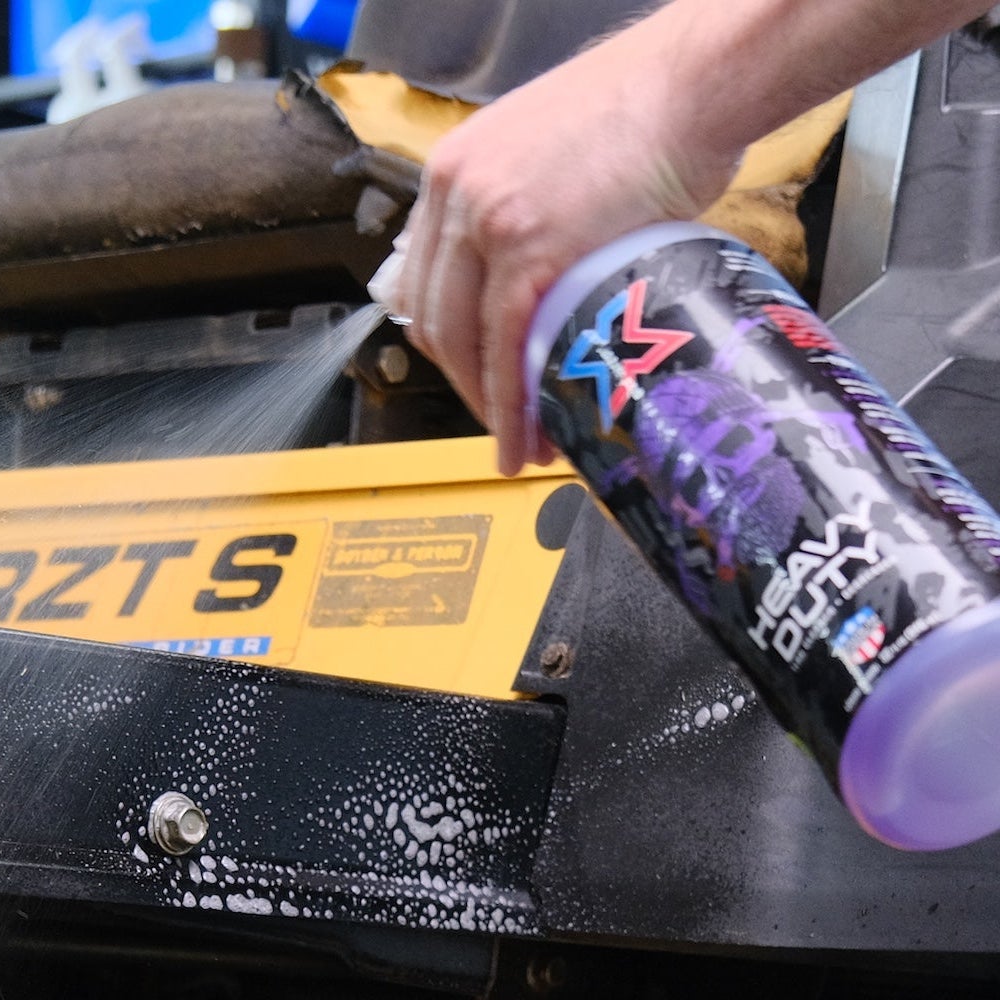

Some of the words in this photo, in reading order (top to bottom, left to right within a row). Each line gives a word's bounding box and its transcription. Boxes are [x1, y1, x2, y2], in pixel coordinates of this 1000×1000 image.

[193, 534, 297, 613] S
[747, 501, 872, 650] HEAVY
[772, 530, 880, 663] DUTY
